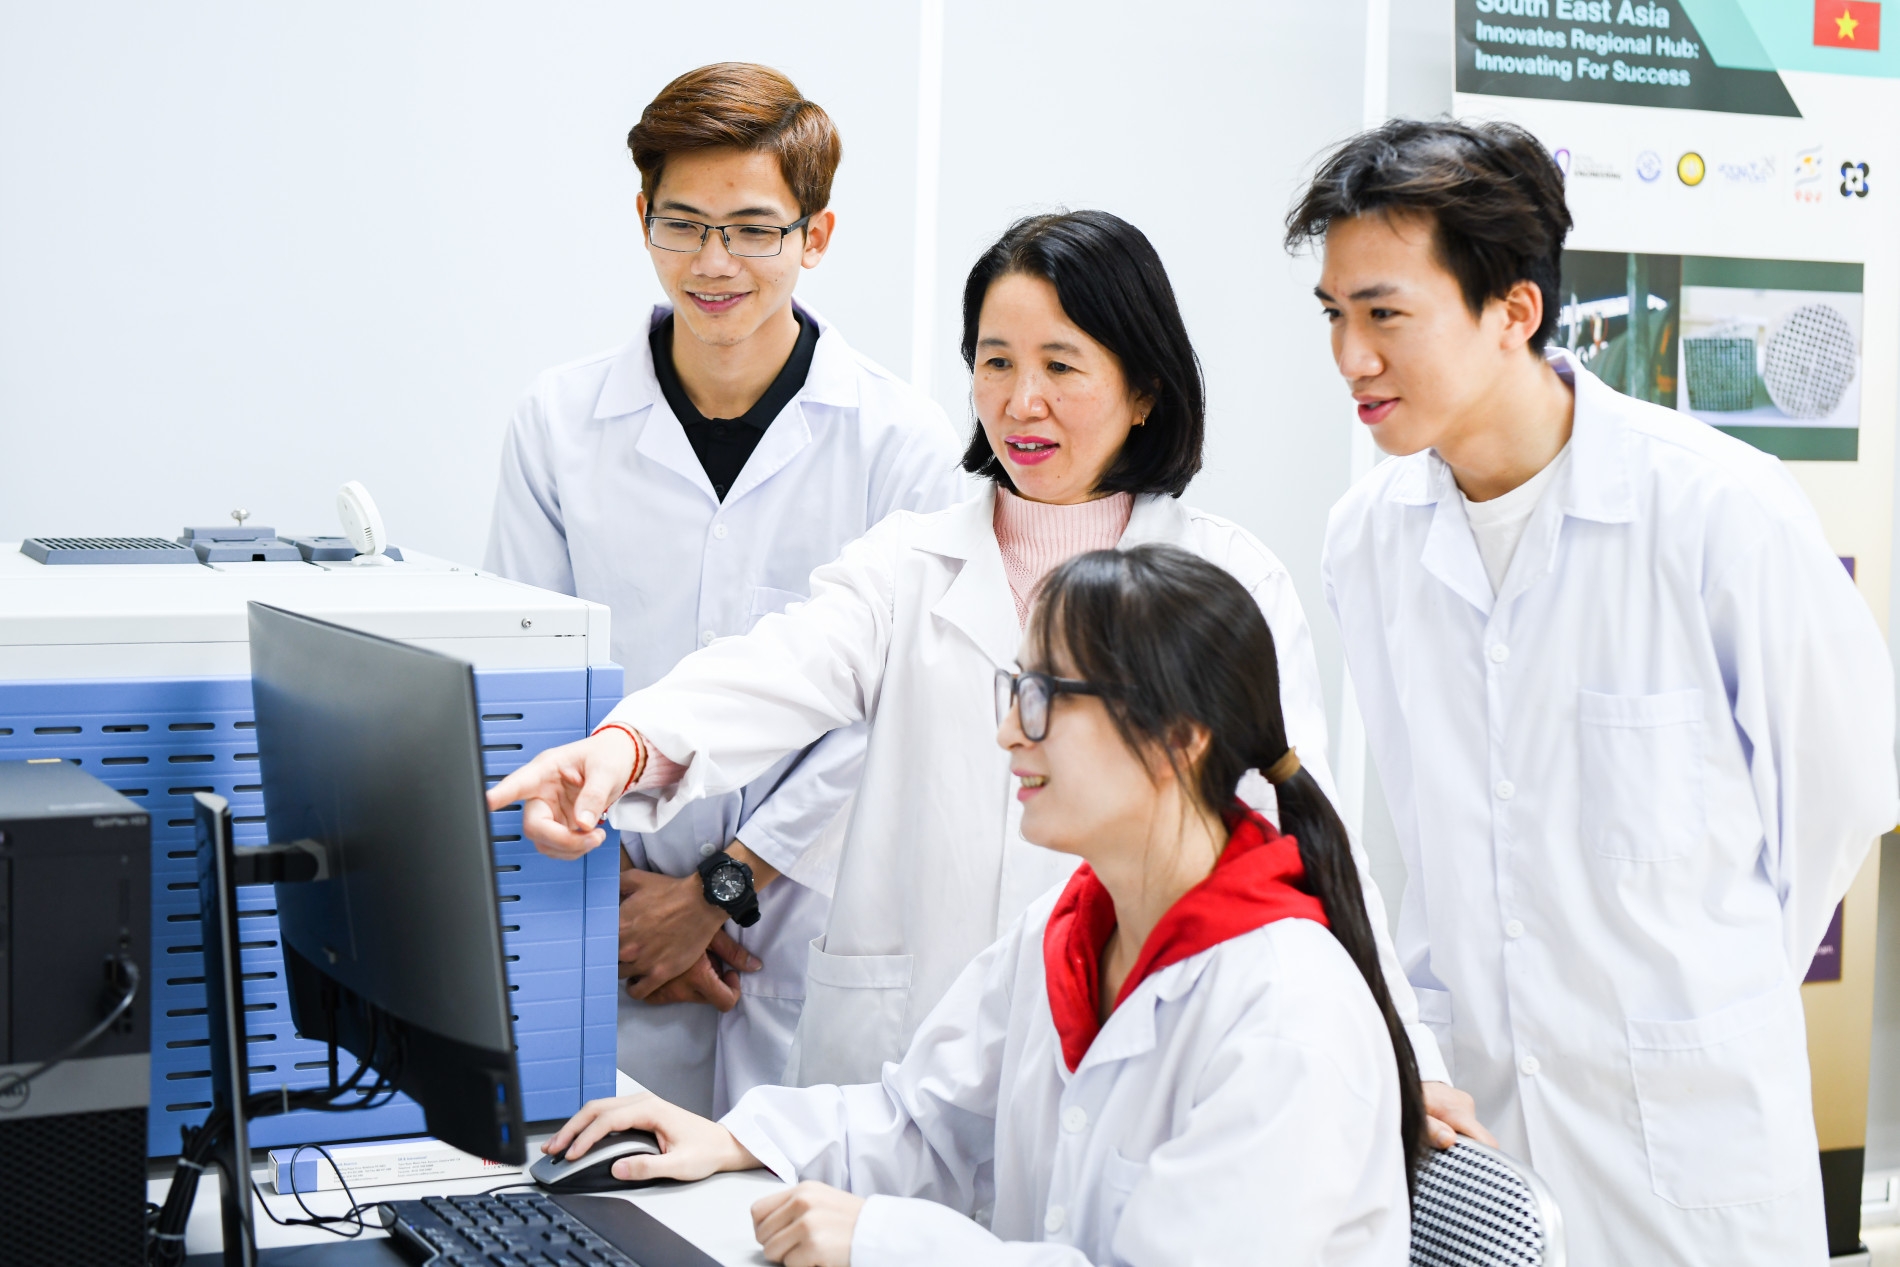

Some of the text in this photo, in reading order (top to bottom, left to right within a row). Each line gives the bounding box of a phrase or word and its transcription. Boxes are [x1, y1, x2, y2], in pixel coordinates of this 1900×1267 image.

[1476, 0, 1670, 28] South East Asia
[1475, 19, 1699, 59] Innovates Regional Hub:
[1475, 48, 1691, 87] Innovating For Success
